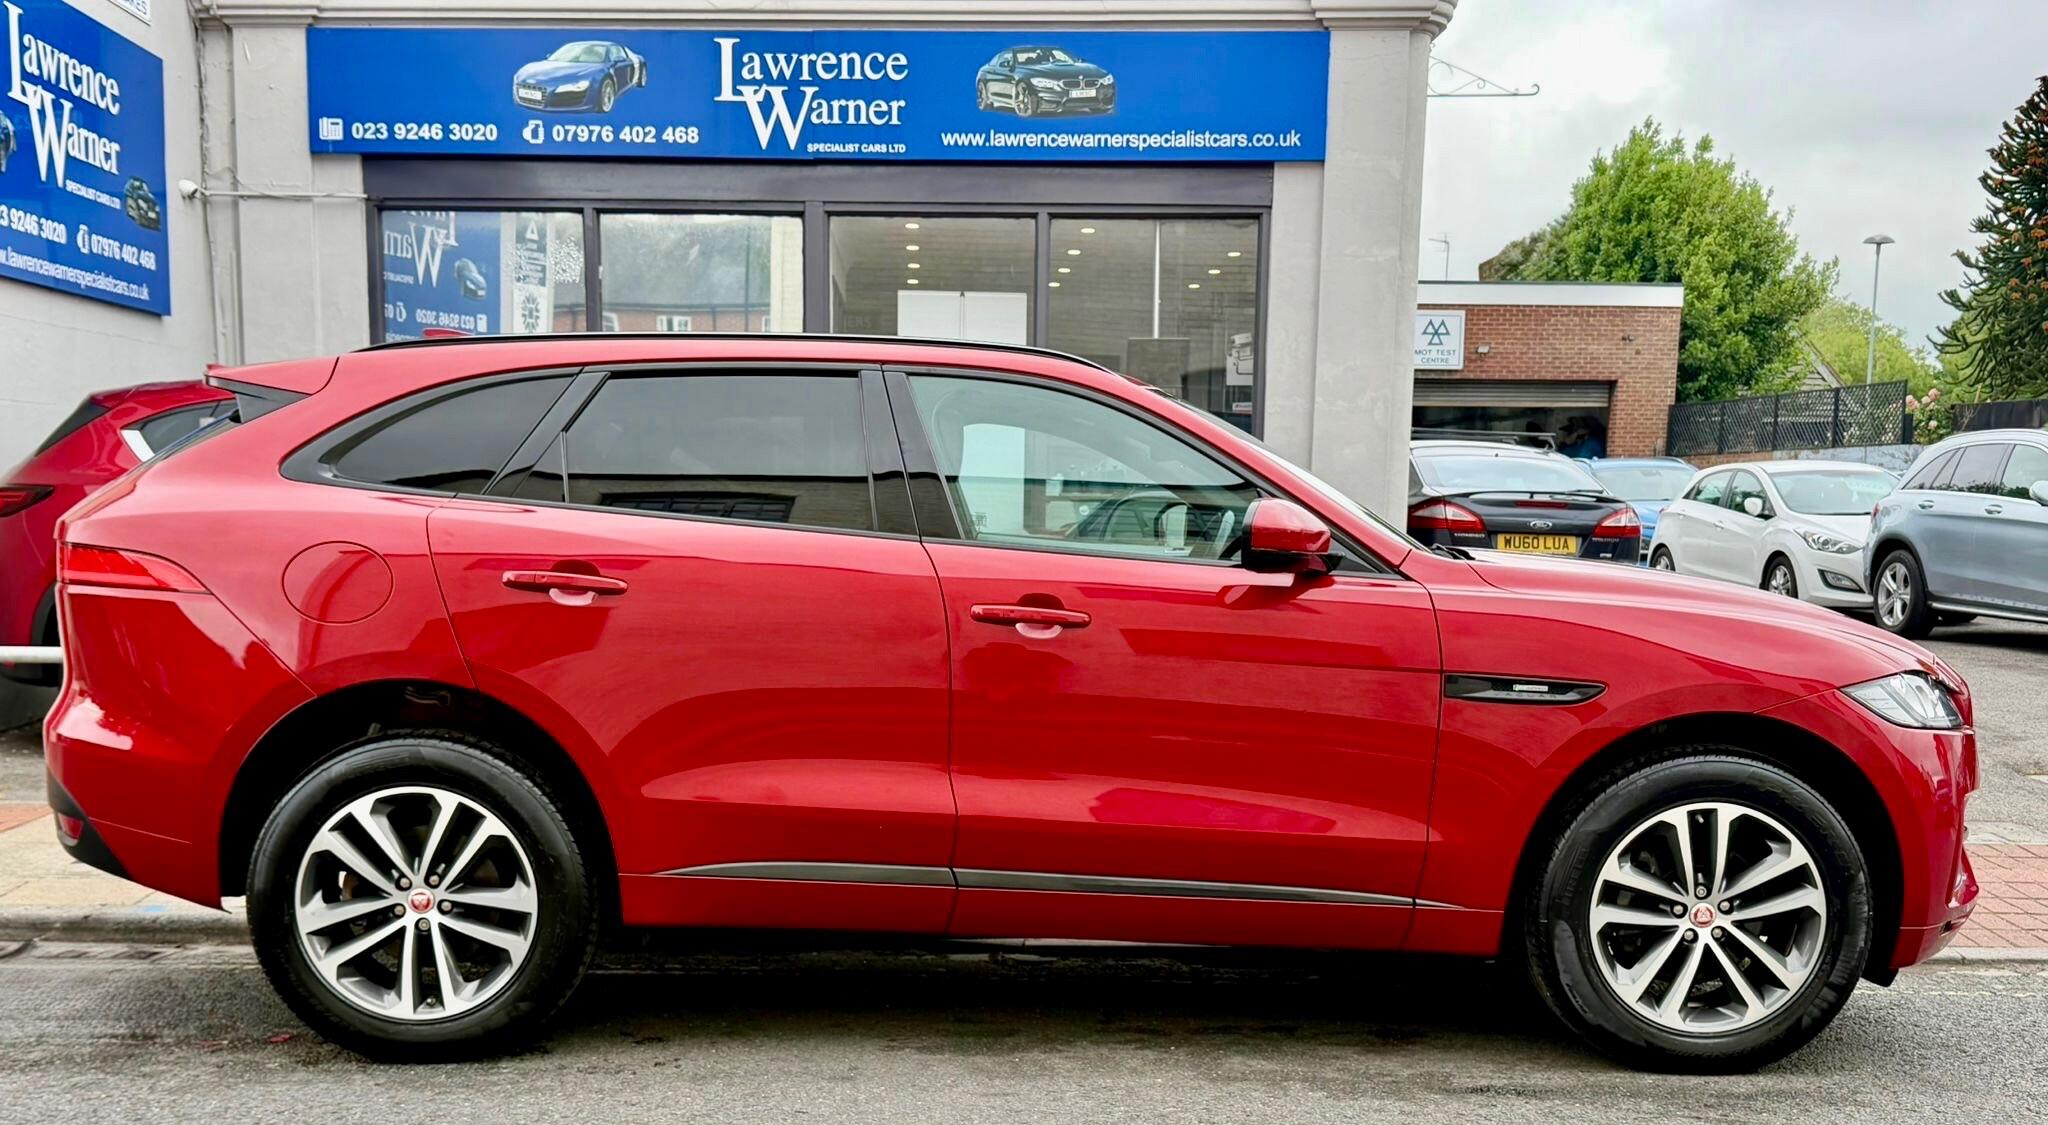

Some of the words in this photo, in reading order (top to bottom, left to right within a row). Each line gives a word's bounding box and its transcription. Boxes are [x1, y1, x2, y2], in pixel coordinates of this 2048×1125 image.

[4, 0, 120, 116] Lawrence
[713, 37, 909, 102] Lawrence
[351, 122, 389, 140] 023
[394, 122, 442, 141] 9246
[448, 122, 498, 142] 3020
[736, 84, 906, 151] Warner
[21, 80, 121, 188] Warner
[551, 123, 614, 143] 07976
[619, 124, 656, 144] 402
[661, 125, 700, 144] 468
[806, 143, 860, 153] SPECIALIST
[861, 144, 887, 153] CARS
[888, 144, 907, 153] LTD
[940, 129, 1301, 152] www.lawrencewarnerspecialistcars.co.uk
[0, 203, 9, 228] 3
[10, 207, 39, 237] 9246
[40, 217, 67, 245] 3020
[91, 233, 121, 260] 07976
[121, 243, 139, 267] 402
[139, 249, 157, 271] 468
[1436, 349, 1457, 357] TEST
[1503, 536, 1540, 550] WU60
[1544, 537, 1570, 552] LUA
